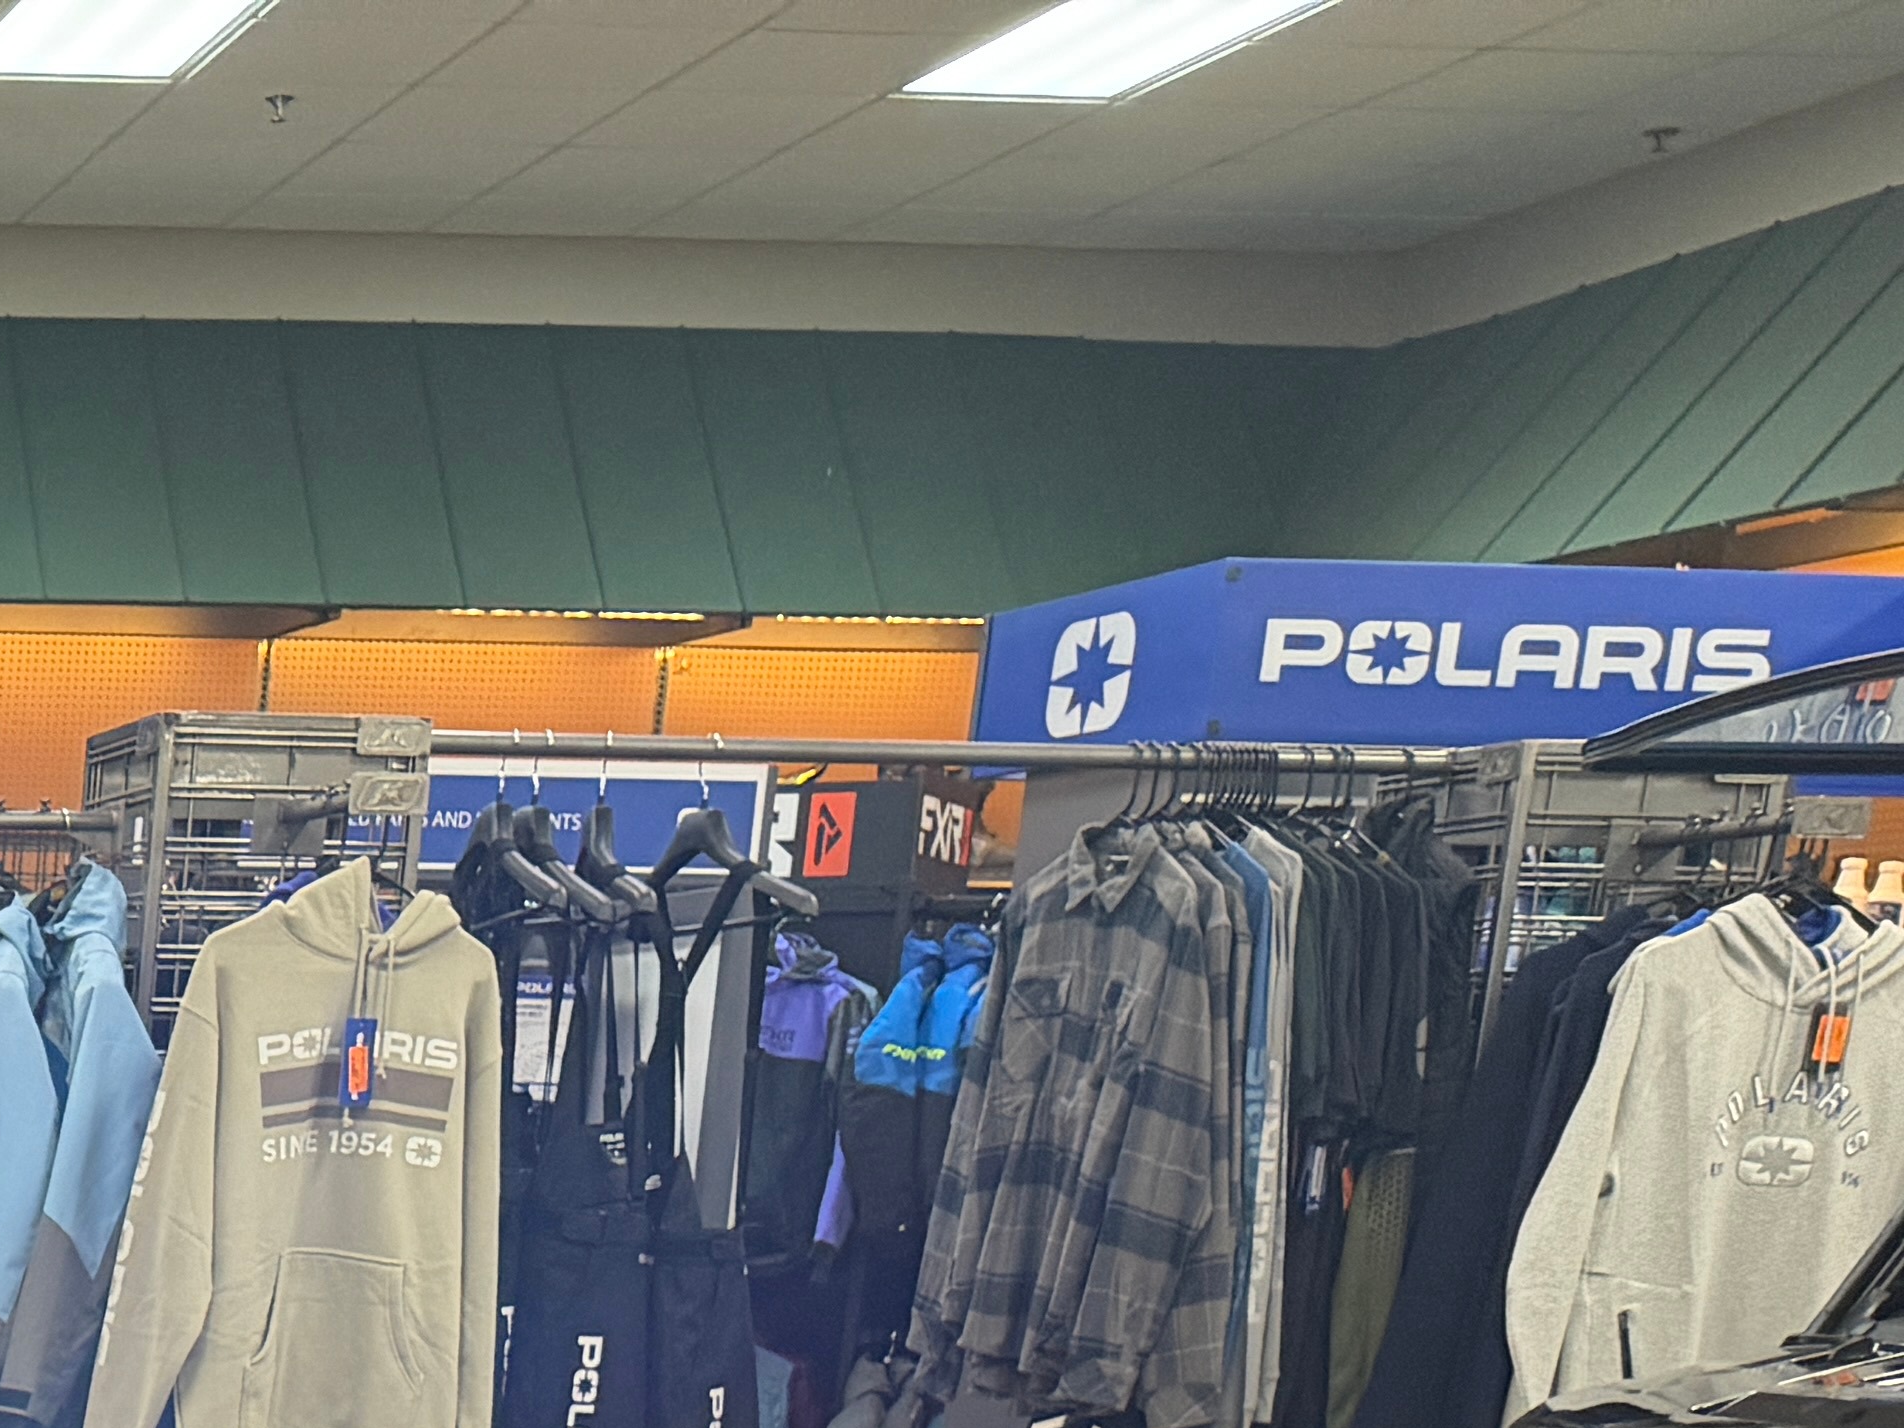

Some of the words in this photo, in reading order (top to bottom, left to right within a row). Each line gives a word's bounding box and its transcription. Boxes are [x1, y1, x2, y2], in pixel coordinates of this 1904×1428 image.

[1259, 618, 1772, 692] POLARIS
[432, 809, 472, 829] AND
[257, 1027, 459, 1070] POLRIS
[328, 1129, 394, 1158] 1954
